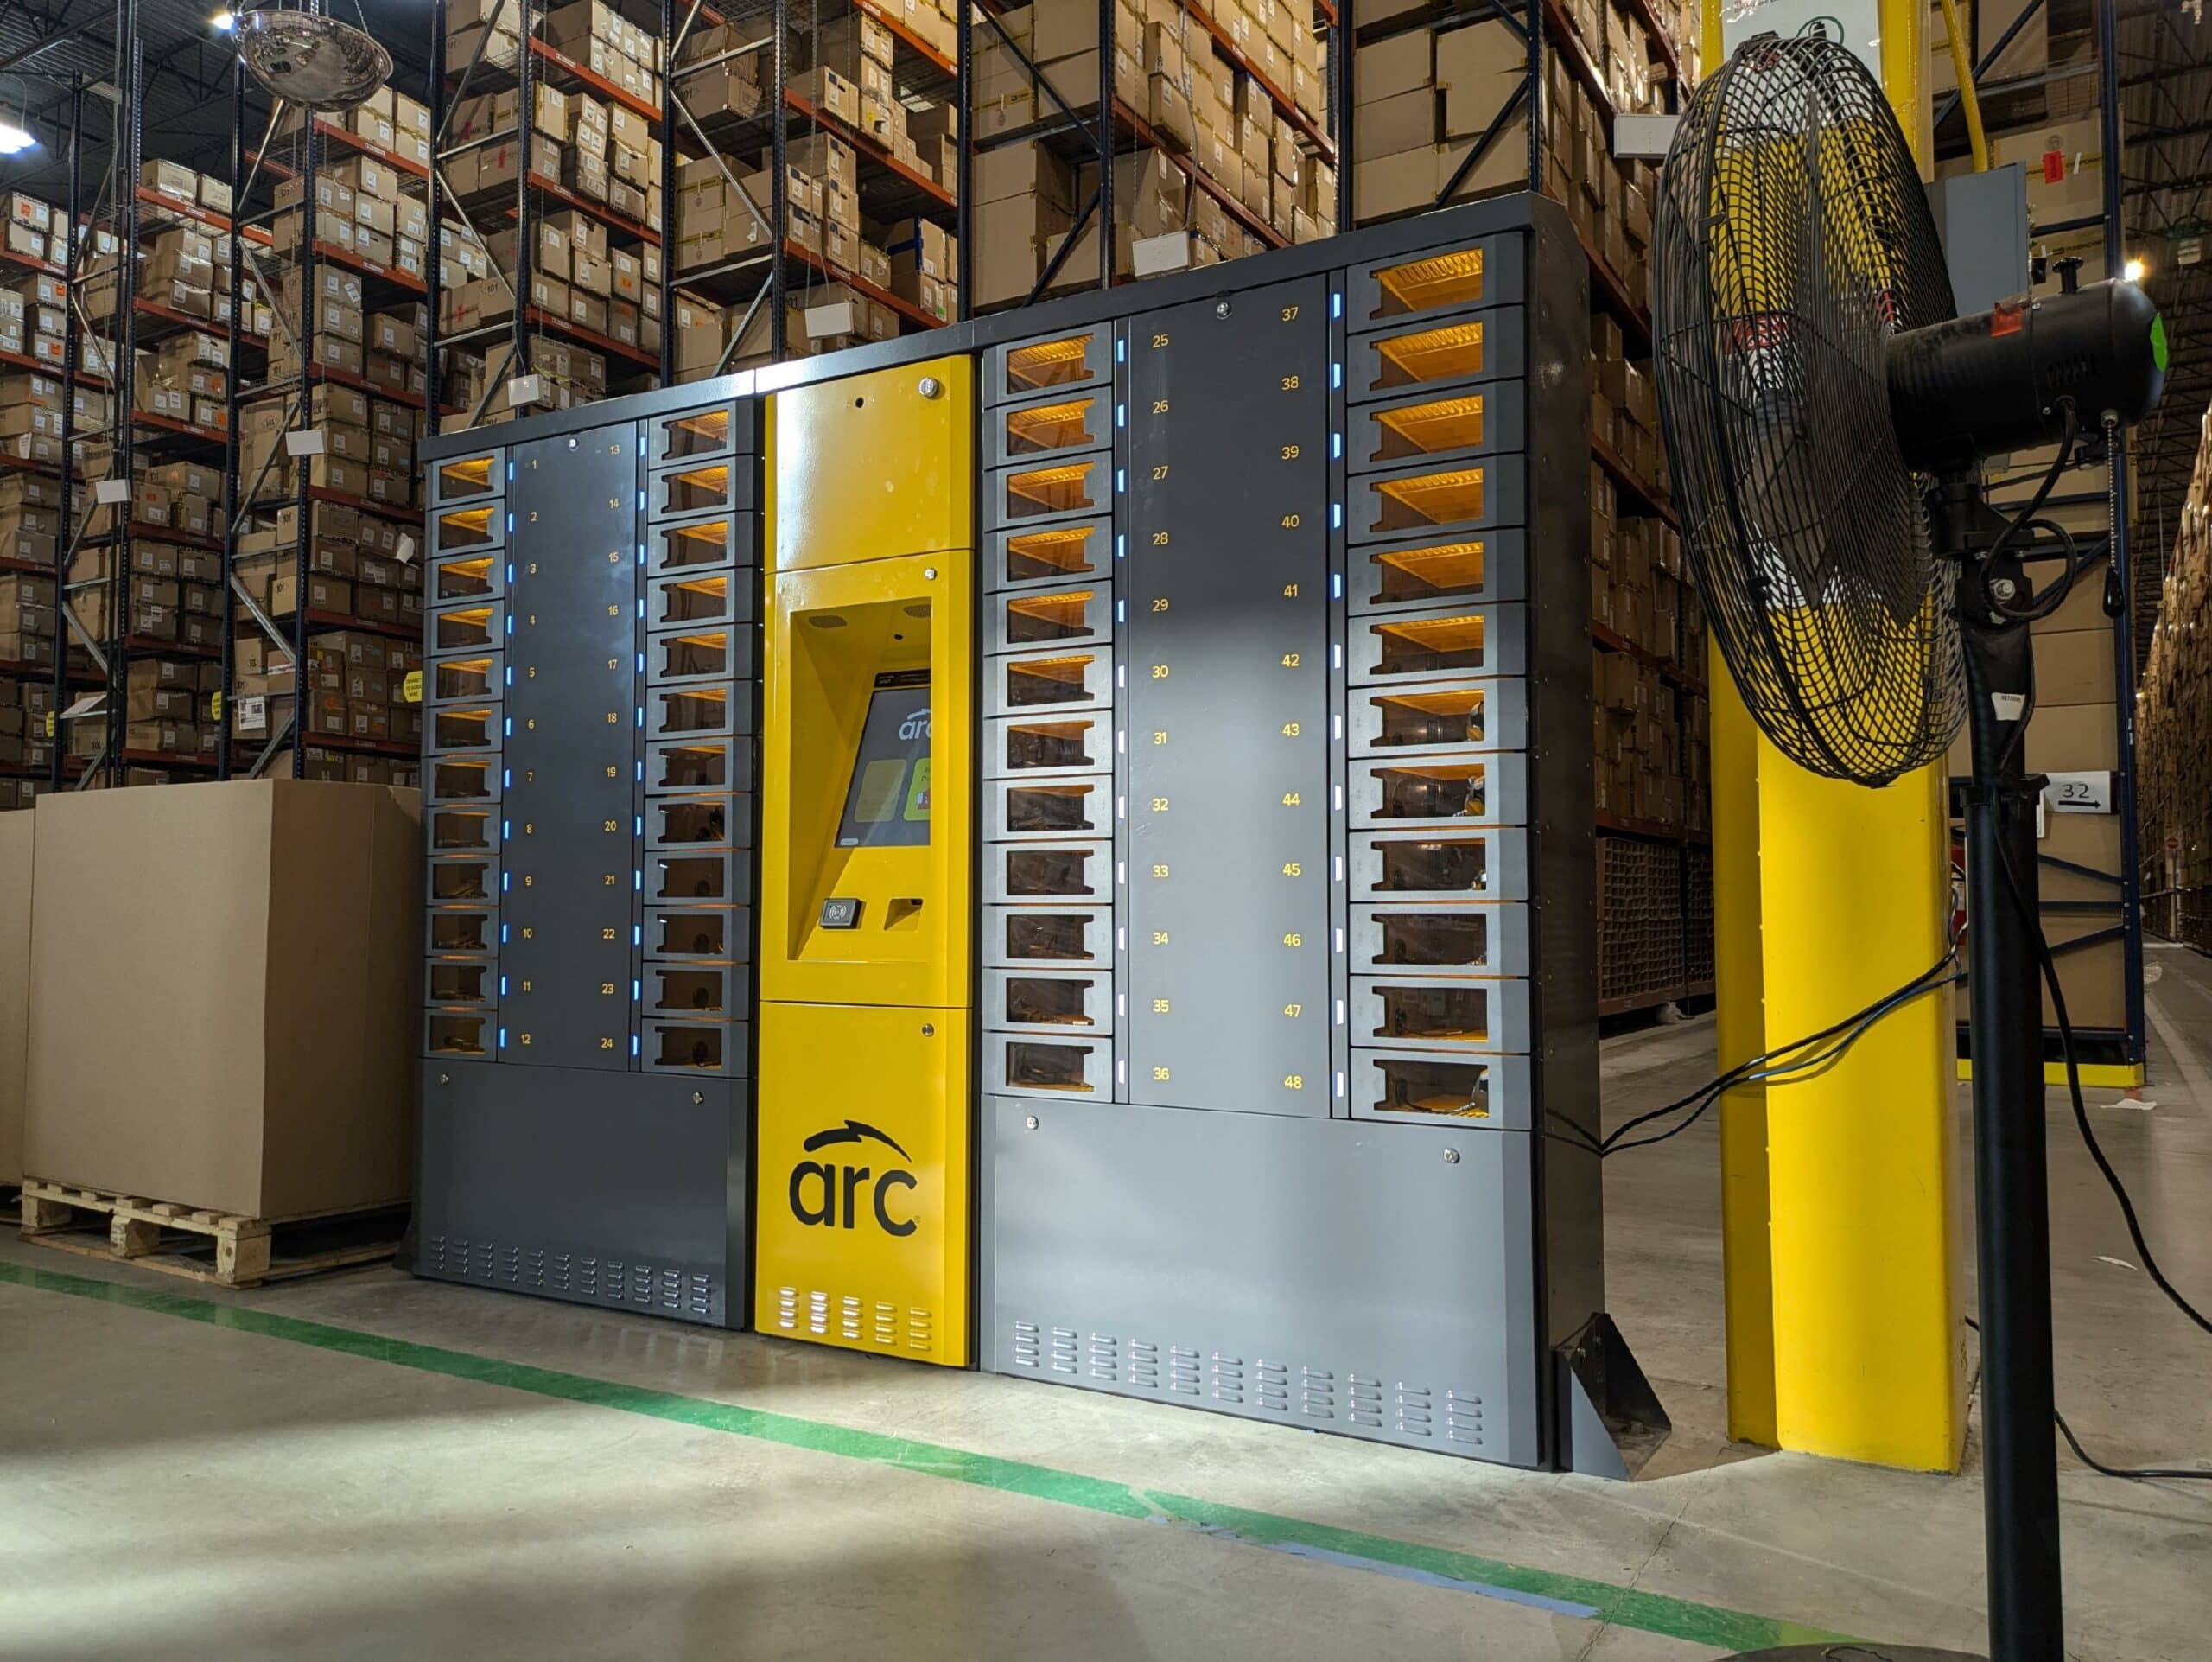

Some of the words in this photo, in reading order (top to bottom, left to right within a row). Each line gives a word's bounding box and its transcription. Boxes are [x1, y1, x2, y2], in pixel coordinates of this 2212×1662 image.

[1282, 306, 1299, 321] 37
[1152, 334, 1169, 349] 25
[1282, 376, 1300, 391] 38
[1154, 400, 1169, 414] 26
[609, 444, 620, 455] 13
[1282, 446, 1300, 460] 39
[531, 459, 537, 469] 1
[1153, 465, 1170, 481] 27
[608, 498, 620, 509] 14
[531, 512, 537, 522] 2
[1282, 514, 1300, 527] 40
[1154, 532, 1168, 546] 28
[608, 551, 619, 563] 15
[530, 564, 537, 575] 3
[1283, 584, 1299, 597] 41
[608, 605, 618, 615] 16
[1153, 598, 1169, 612] 29
[529, 614, 536, 625] 4
[608, 659, 618, 670] 17
[1282, 653, 1300, 667] 42
[529, 667, 536, 678] 5
[1153, 665, 1169, 678] 30
[607, 712, 617, 723] 18
[528, 720, 534, 729] 6
[1282, 723, 1300, 736] 43
[1154, 731, 1168, 745] 31
[527, 771, 534, 781] 7
[607, 767, 616, 777] 19
[2062, 783, 2090, 799] 32
[1153, 798, 1168, 812] 32
[1283, 793, 1300, 806] 44
[526, 824, 533, 834] 8
[606, 821, 617, 831] 20
[1154, 865, 1169, 878] 33
[1283, 863, 1300, 876] 45
[525, 876, 532, 886] 9
[605, 875, 615, 885] 21
[523, 927, 532, 938] 10
[604, 928, 615, 939] 22
[1154, 932, 1169, 945] 34
[1284, 934, 1301, 946] 46
[522, 981, 531, 991] 11
[602, 984, 614, 995] 23
[1154, 999, 1169, 1013] 35
[1284, 1003, 1302, 1016] 47
[521, 1034, 531, 1045] 12
[602, 1038, 613, 1048] 24
[1154, 1067, 1170, 1081] 36
[1285, 1075, 1303, 1089] 48
[790, 1160, 918, 1237] arc
